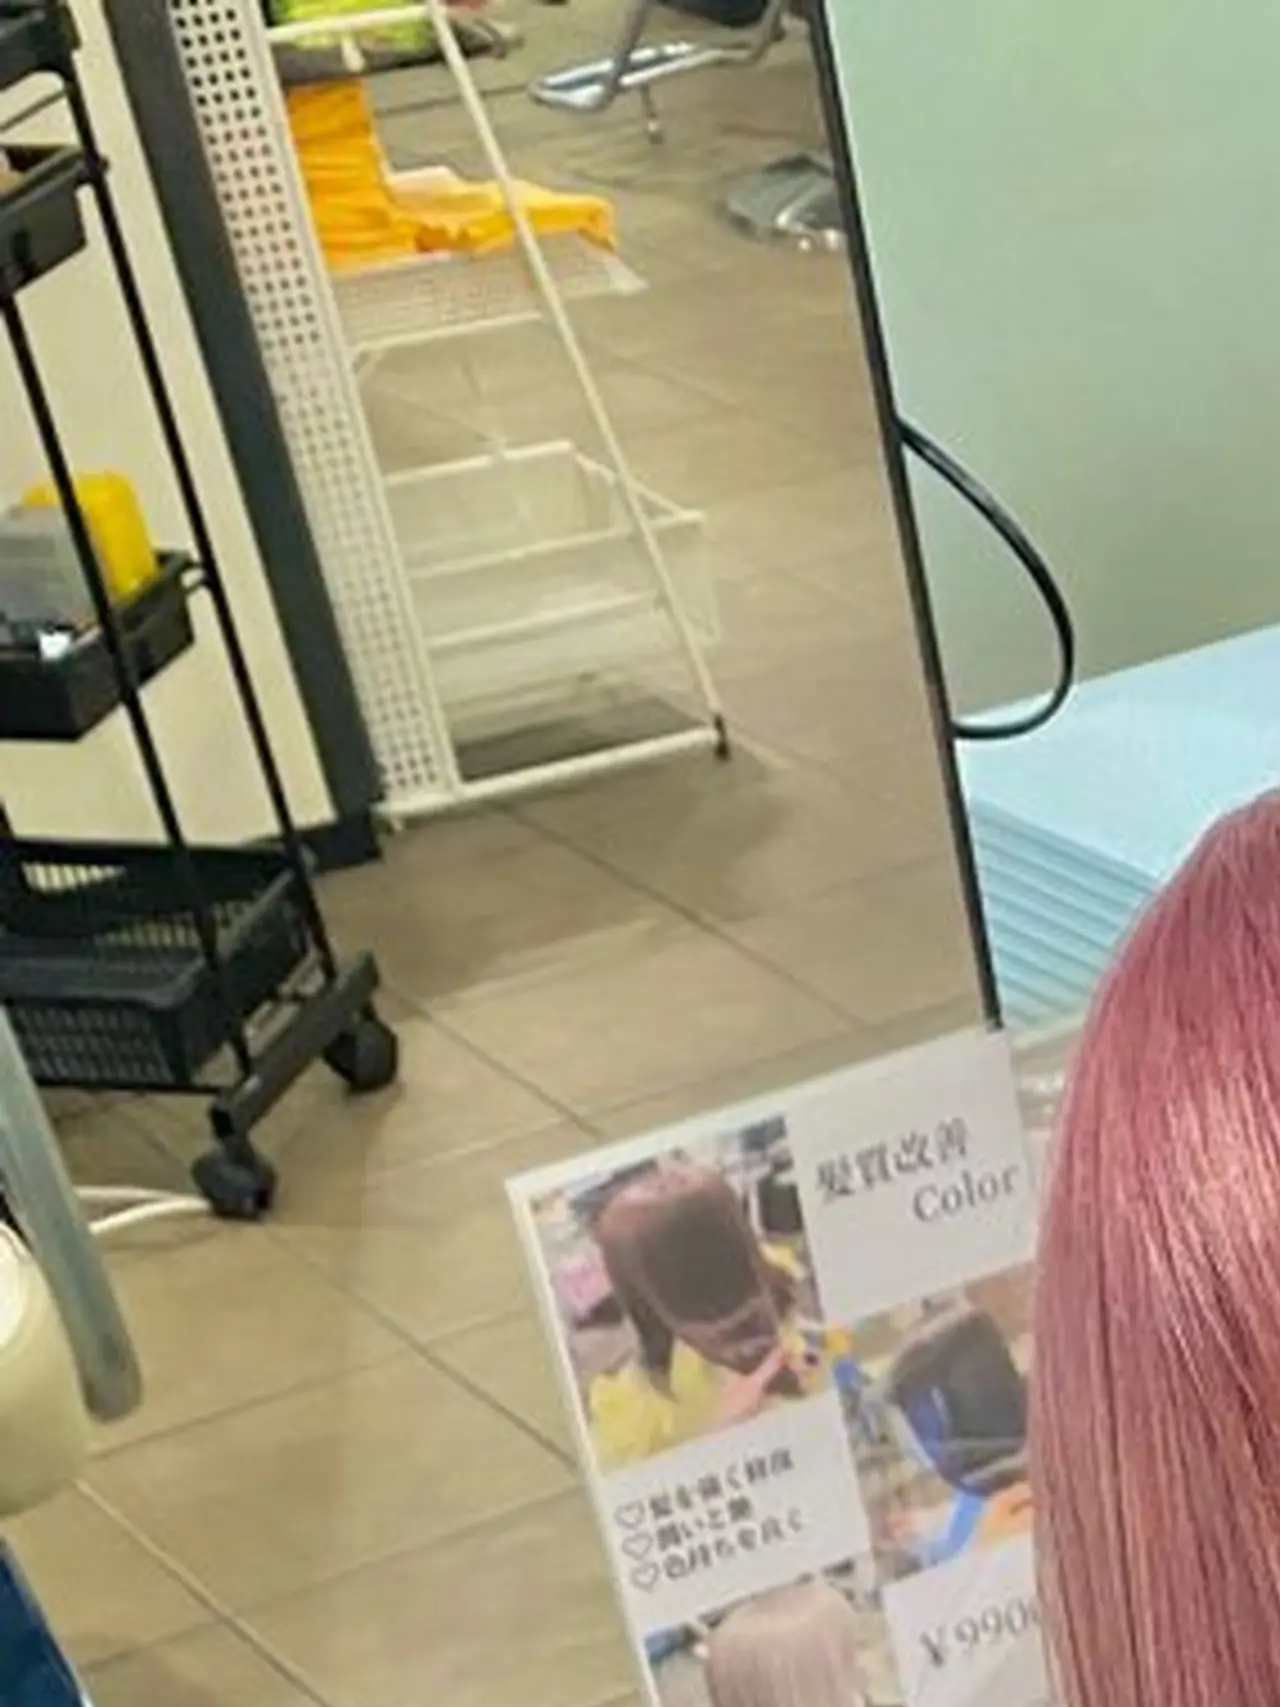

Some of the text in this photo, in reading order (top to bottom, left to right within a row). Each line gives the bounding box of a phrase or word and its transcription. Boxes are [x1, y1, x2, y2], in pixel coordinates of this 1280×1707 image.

[817, 1117, 969, 1204] 髪質改善
[912, 1163, 1019, 1223] Color
